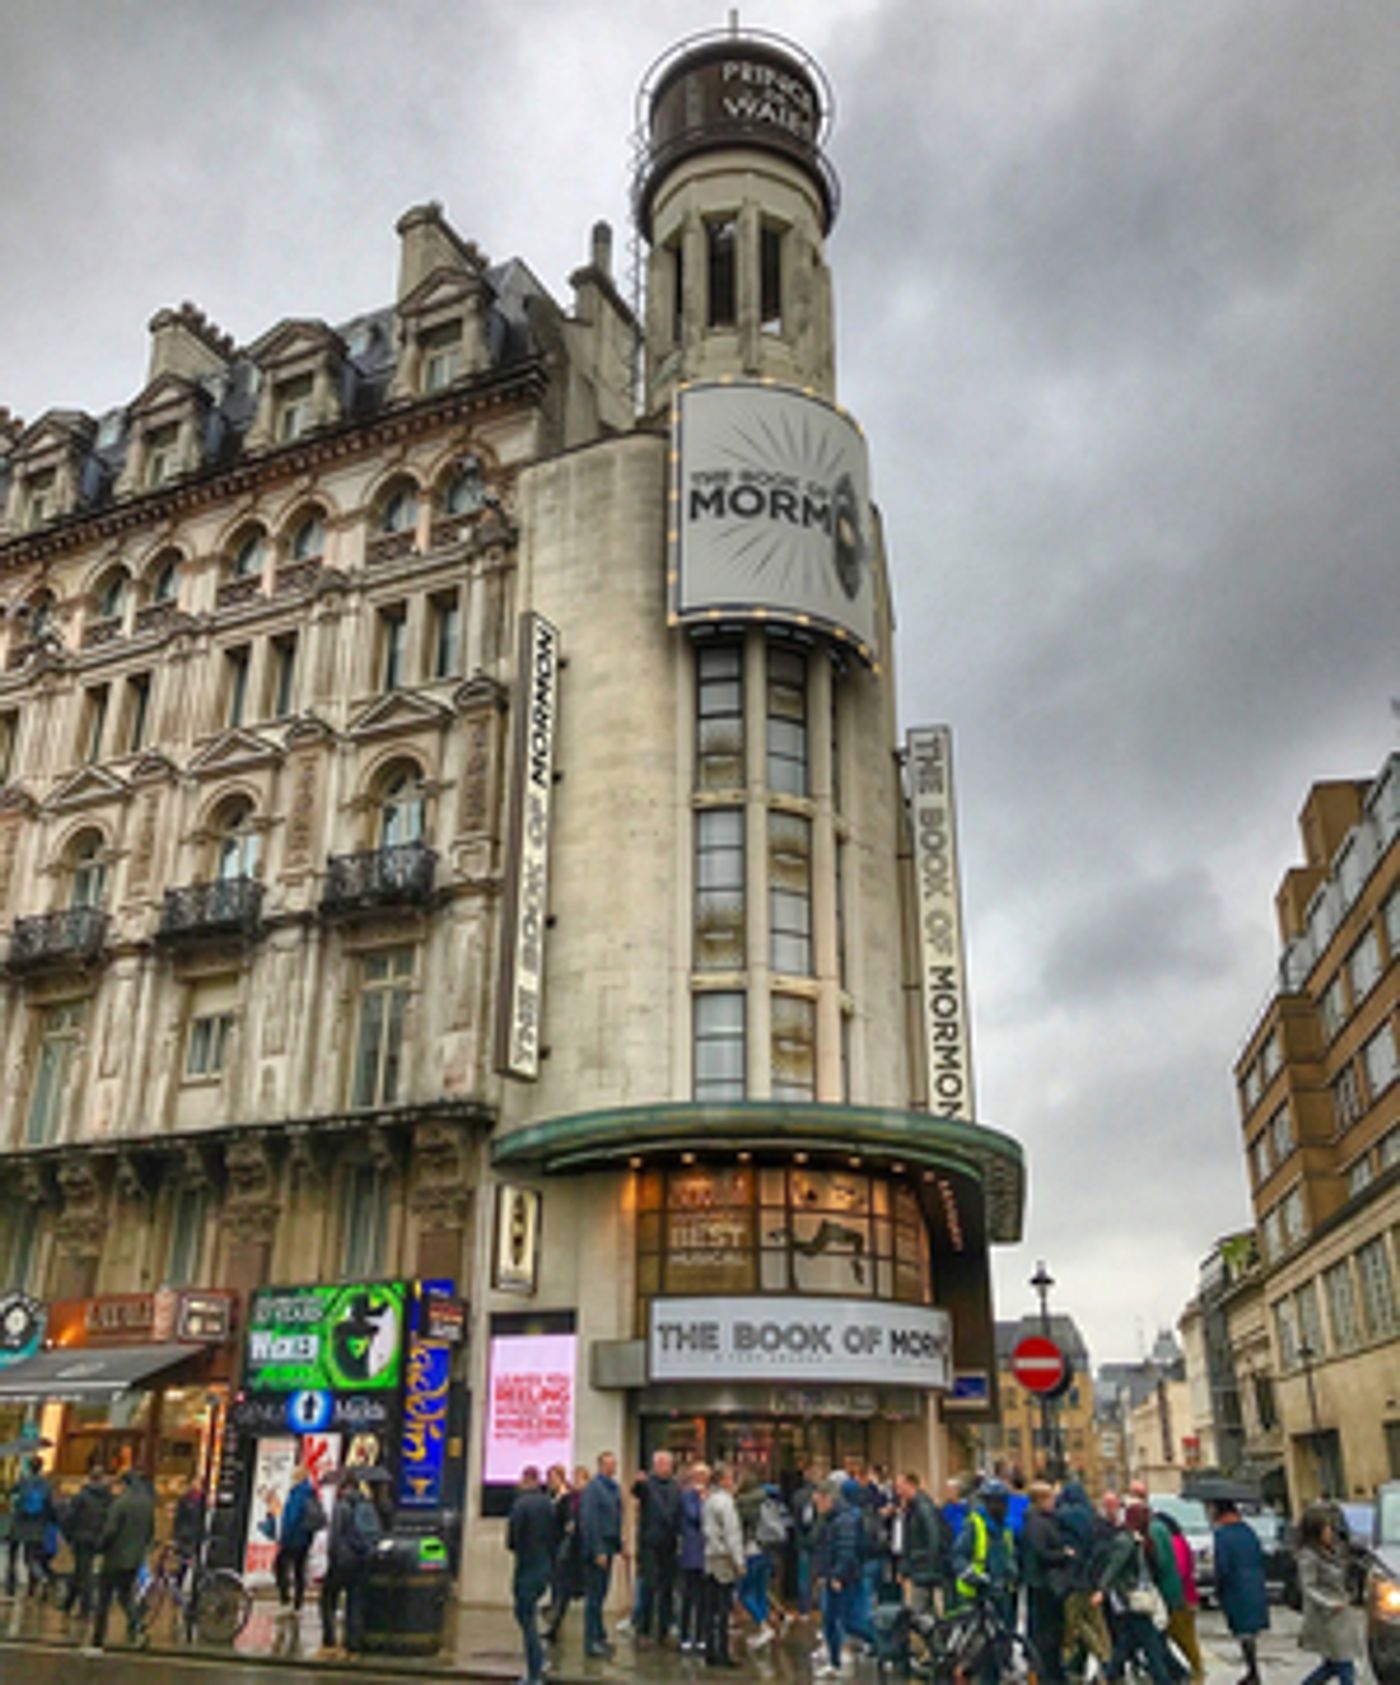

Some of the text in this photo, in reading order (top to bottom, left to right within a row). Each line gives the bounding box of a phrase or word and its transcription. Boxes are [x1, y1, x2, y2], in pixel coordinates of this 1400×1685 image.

[532, 625, 552, 789] MORMON
[915, 734, 943, 794] THE
[919, 807, 951, 898] BOOK
[924, 909, 954, 956] OF
[658, 1323, 720, 1351] THE
[732, 1322, 832, 1354] BOOK
[843, 1325, 882, 1355] OF
